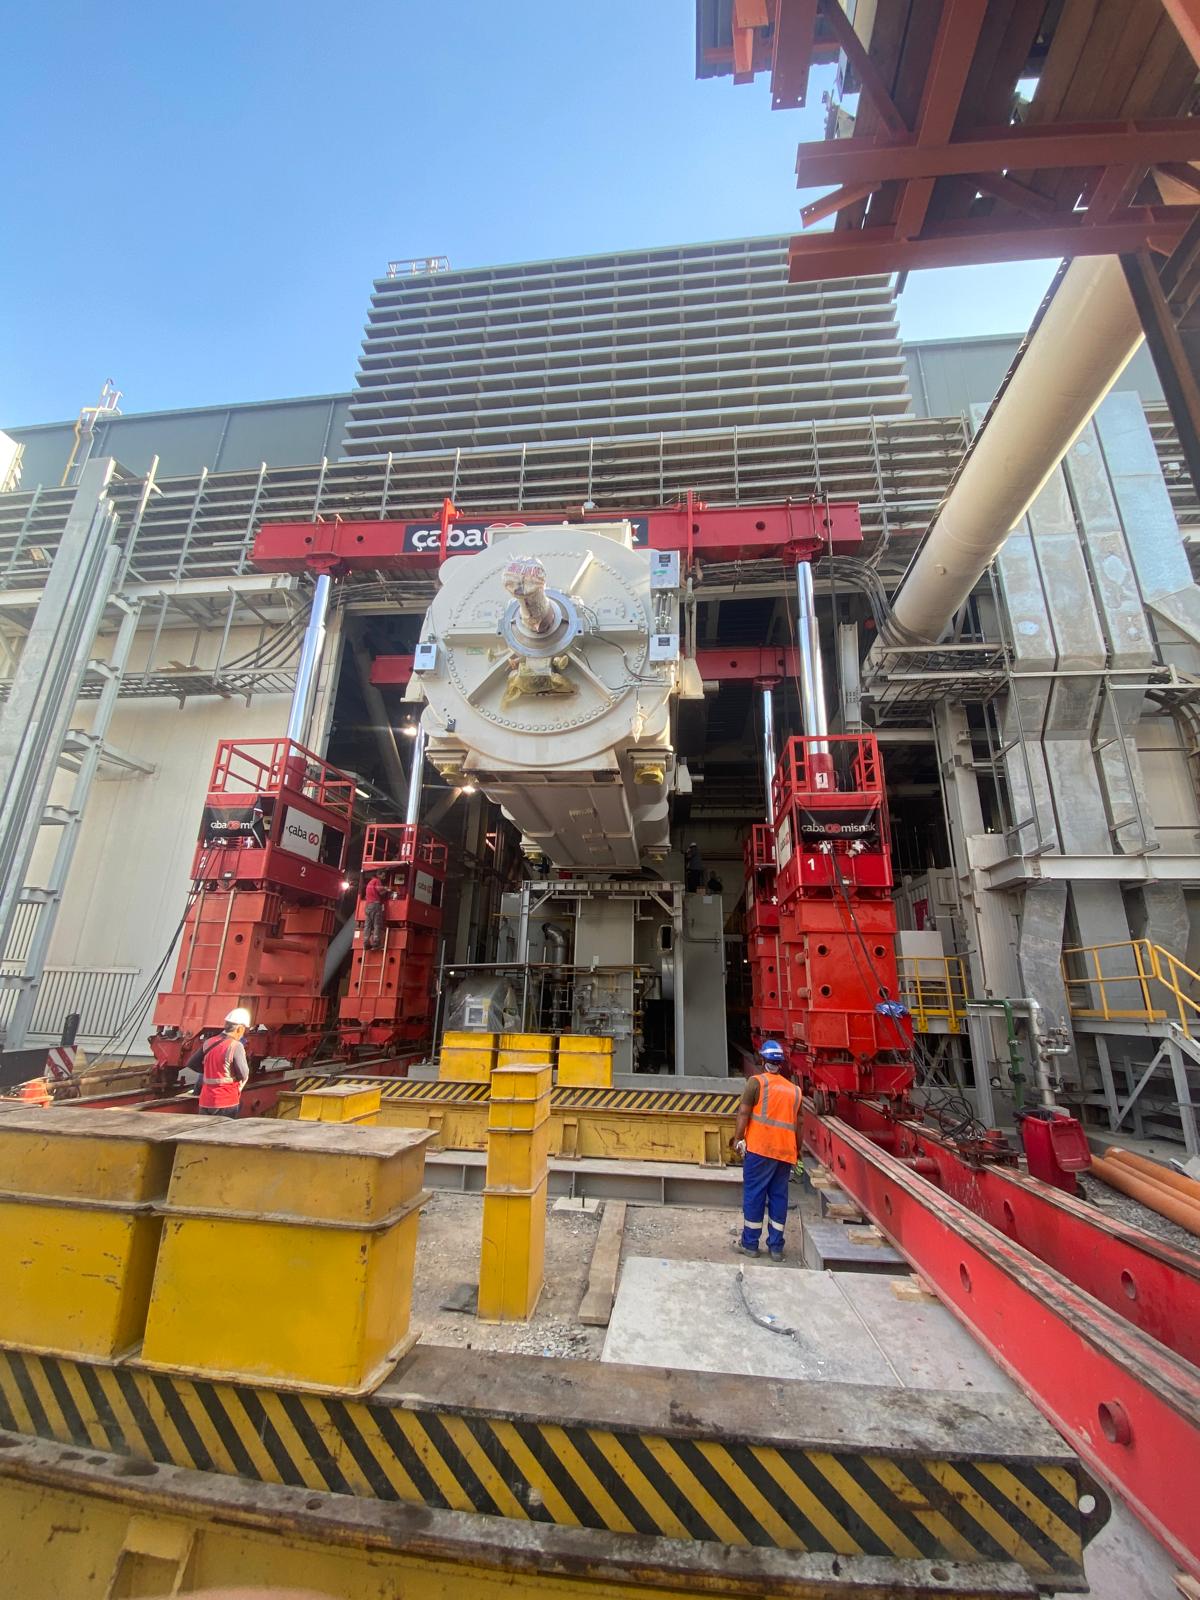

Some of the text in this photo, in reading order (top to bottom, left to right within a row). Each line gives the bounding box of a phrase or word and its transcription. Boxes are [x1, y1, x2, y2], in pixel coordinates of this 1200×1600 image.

[411, 524, 483, 552] çaba
[818, 773, 824, 784] 1
[807, 858, 815, 871] 1
[300, 866, 306, 877] 2
